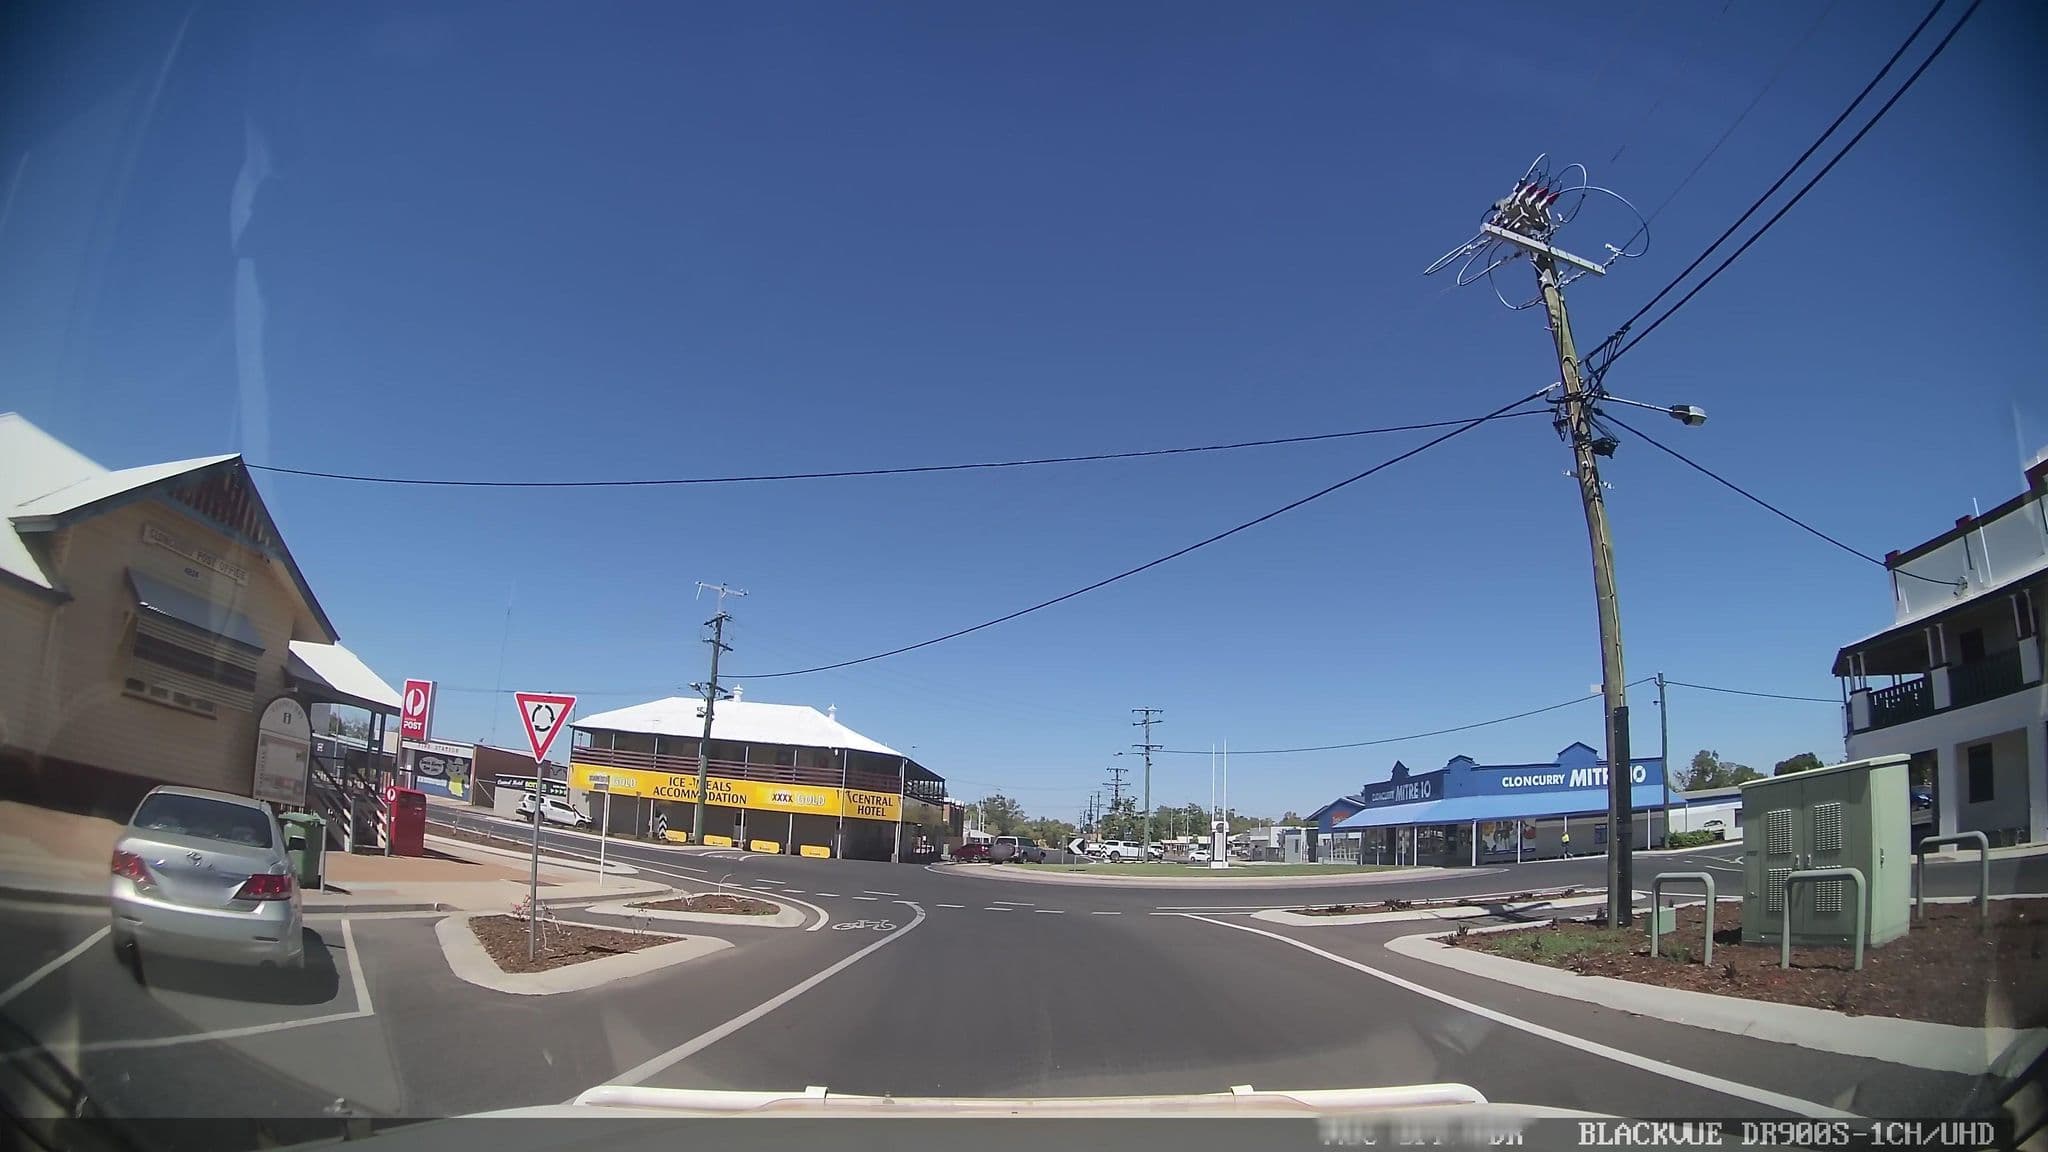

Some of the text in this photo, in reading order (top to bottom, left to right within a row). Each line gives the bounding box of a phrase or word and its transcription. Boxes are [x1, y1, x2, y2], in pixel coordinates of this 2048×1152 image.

[403, 720, 422, 731] POST
[609, 776, 637, 789] GOLD
[669, 776, 686, 788] ICE
[1501, 774, 1566, 788] CLONCURRY
[1569, 766, 1609, 788] MIT
[653, 786, 747, 804] ACCOMMDATION
[1395, 782, 1419, 802] MITRE
[1420, 780, 1431, 798] 10
[771, 792, 826, 806] XXXX GOLD
[853, 793, 893, 807] CENTRAL
[857, 805, 887, 817] HOTEL
